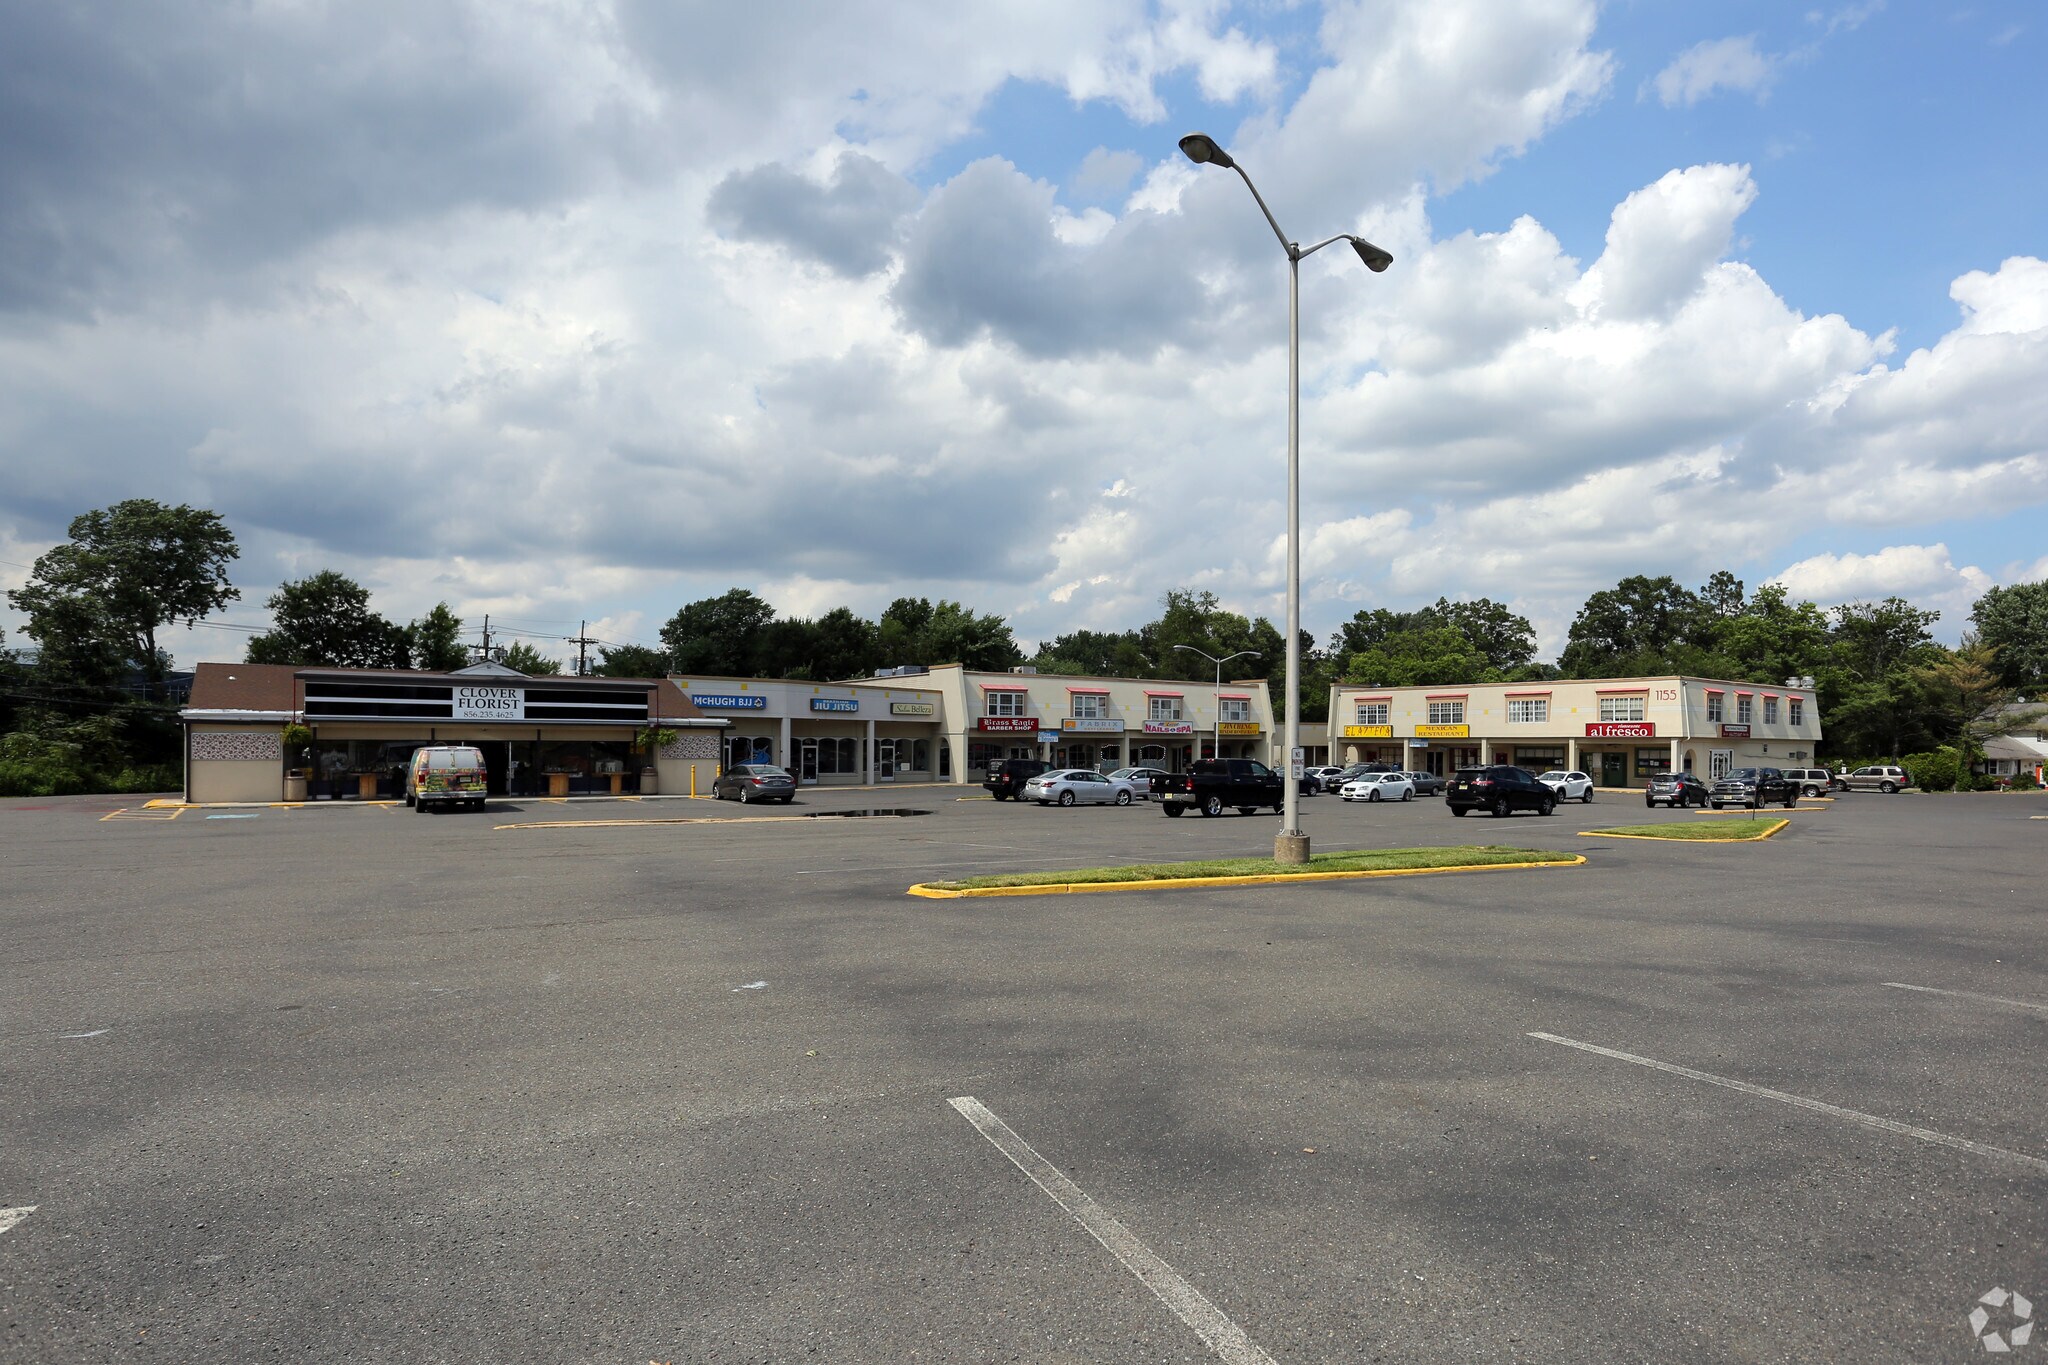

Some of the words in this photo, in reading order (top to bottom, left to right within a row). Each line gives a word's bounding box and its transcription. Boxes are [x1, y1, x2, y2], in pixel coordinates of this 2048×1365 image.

[460, 687, 517, 698] CLOVER
[1655, 690, 1677, 701] 1155
[458, 698, 520, 709] FLORIST
[738, 698, 752, 706] BJJ
[814, 702, 830, 710] JIU
[832, 703, 858, 711] JITSU
[911, 705, 931, 713] Belleza
[1145, 724, 1170, 732] NAILS
[1176, 725, 1191, 733] SPA
[1345, 726, 1355, 736] EL
[1358, 726, 1390, 736] AZTECA
[1590, 726, 1604, 737] al
[1605, 726, 1648, 737] fresco
